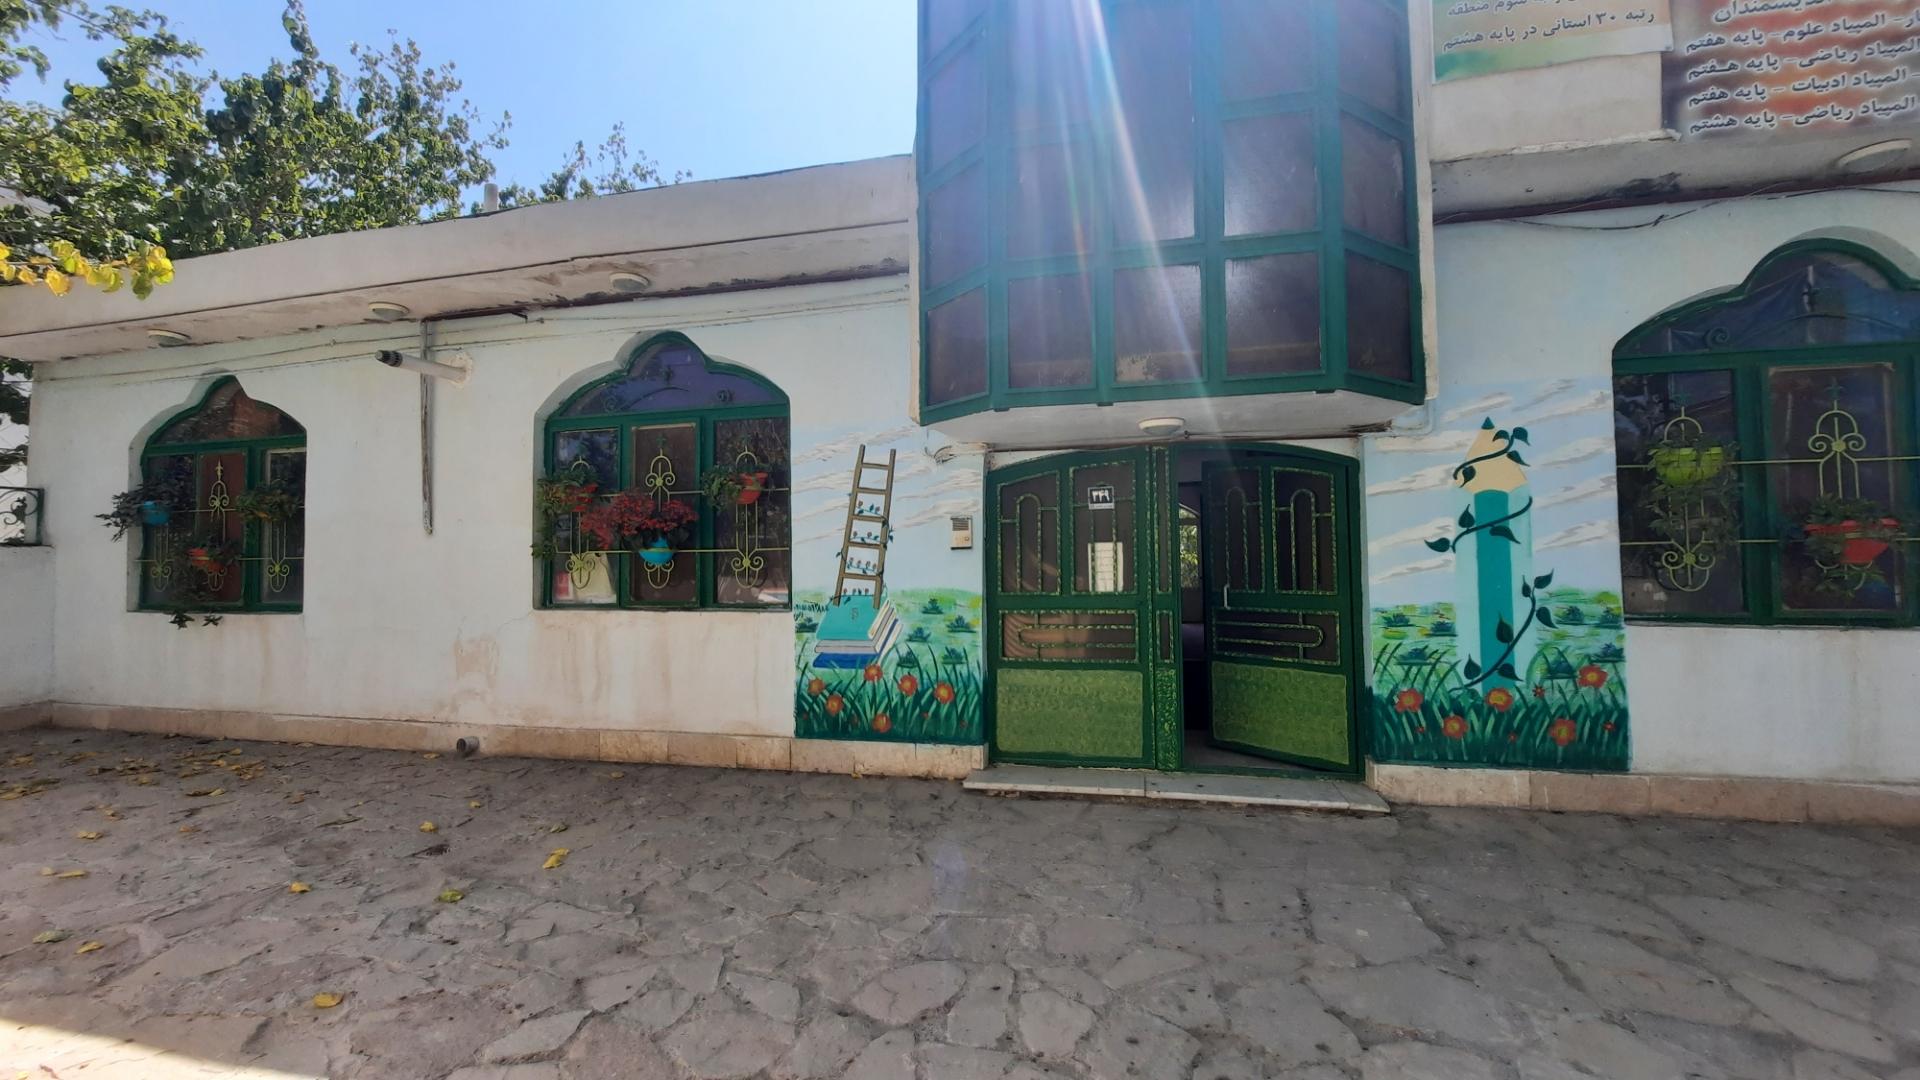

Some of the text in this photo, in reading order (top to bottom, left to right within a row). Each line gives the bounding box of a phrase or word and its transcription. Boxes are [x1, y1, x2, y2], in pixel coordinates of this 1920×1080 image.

[1625, 8, 1655, 22] رتبه
[1831, 14, 1886, 34] المپیاد
[1489, 26, 1515, 42] پایه
[1522, 25, 1537, 40] در
[1543, 15, 1591, 37] استانی
[1443, 32, 1484, 51] هشتم
[1686, 33, 1726, 54] هفتم
[1733, 29, 1763, 46] پایه
[1866, 37, 1920, 58] المپیاد
[1746, 54, 1778, 71] پایه
[1792, 75, 1846, 93] ادبیات
[1852, 68, 1907, 89] المپیاد
[1688, 87, 1729, 107] هفتم
[1735, 84, 1766, 100] پایه
[1860, 96, 1915, 117] المپیاد
[1690, 115, 1738, 134] هشتم
[1744, 111, 1775, 128] پایه
